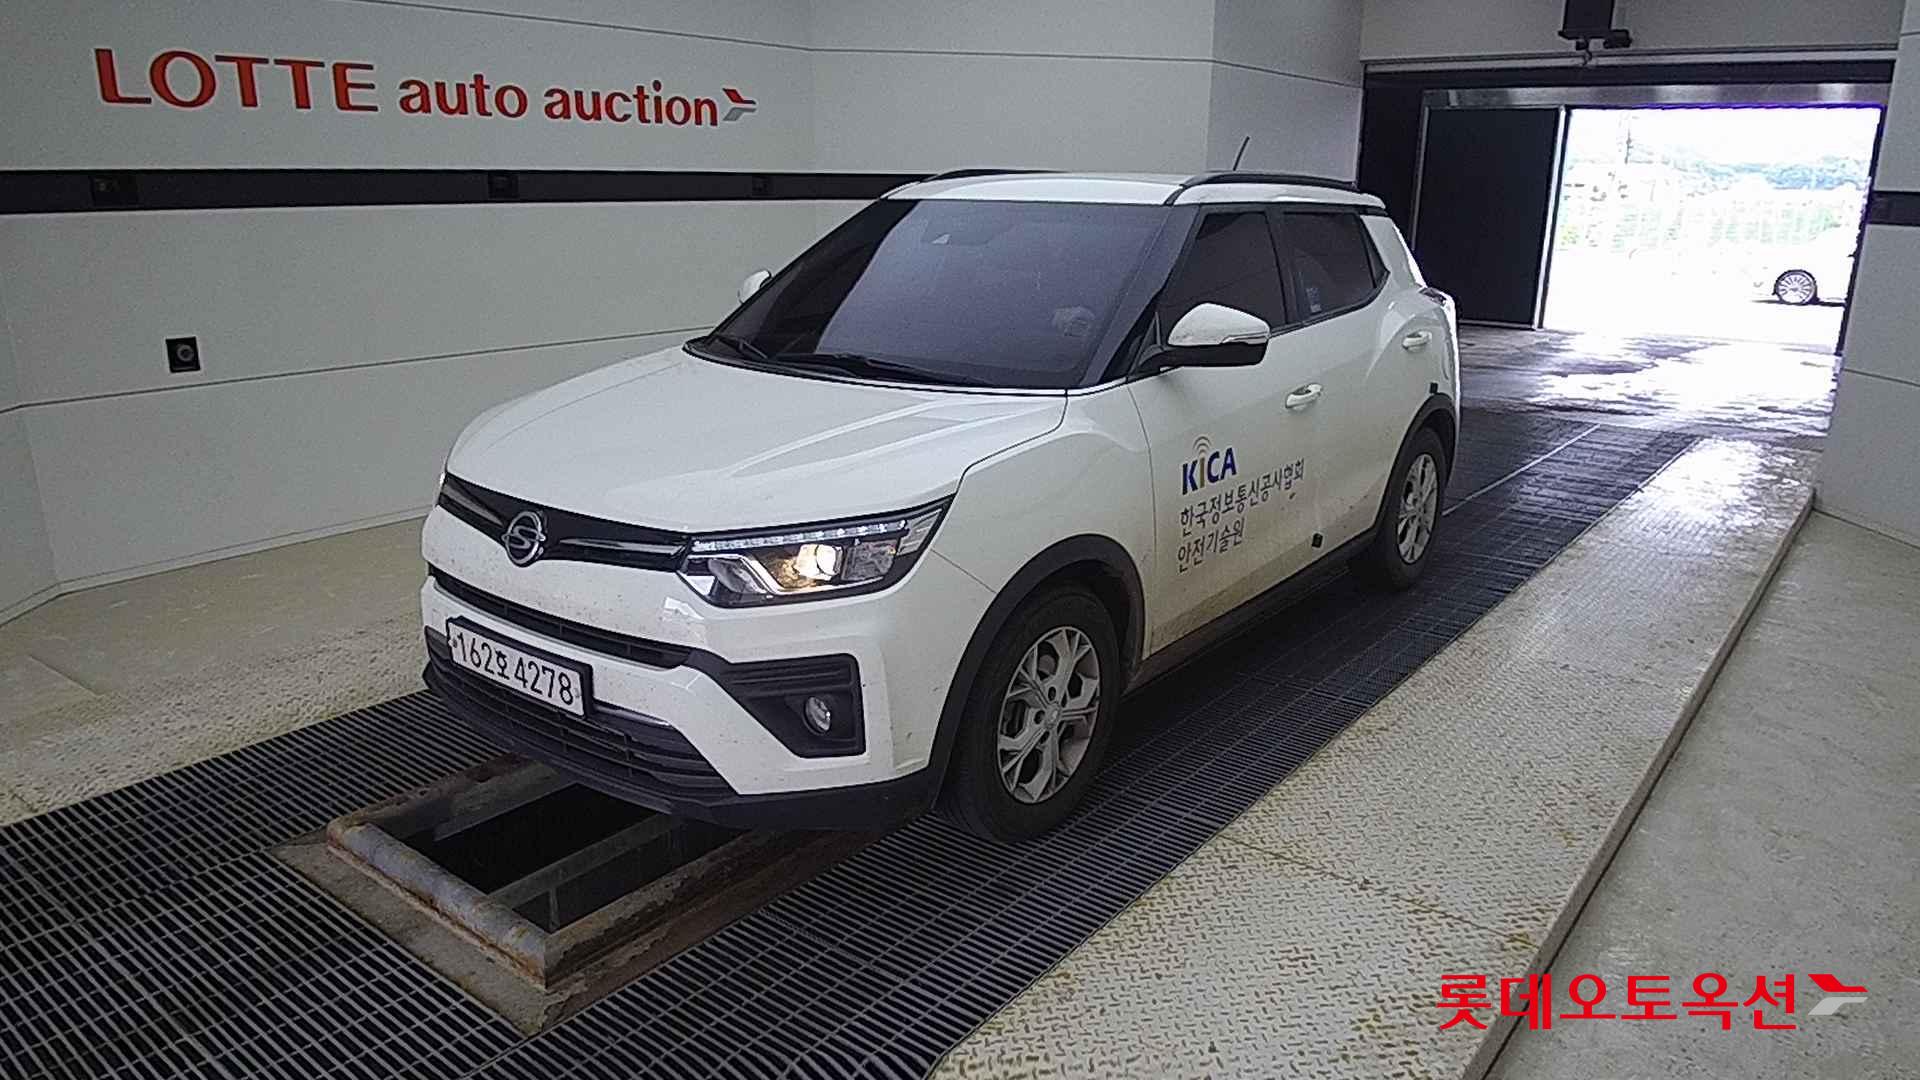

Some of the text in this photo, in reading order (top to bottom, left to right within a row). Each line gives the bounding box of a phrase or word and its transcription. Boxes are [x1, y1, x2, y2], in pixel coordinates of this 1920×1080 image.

[94, 48, 718, 127] LOTTE auto auction
[1180, 458, 1305, 537] 한국정보통신공사협회
[1182, 447, 1237, 495] KICA
[1178, 517, 1245, 573] 안전기술원
